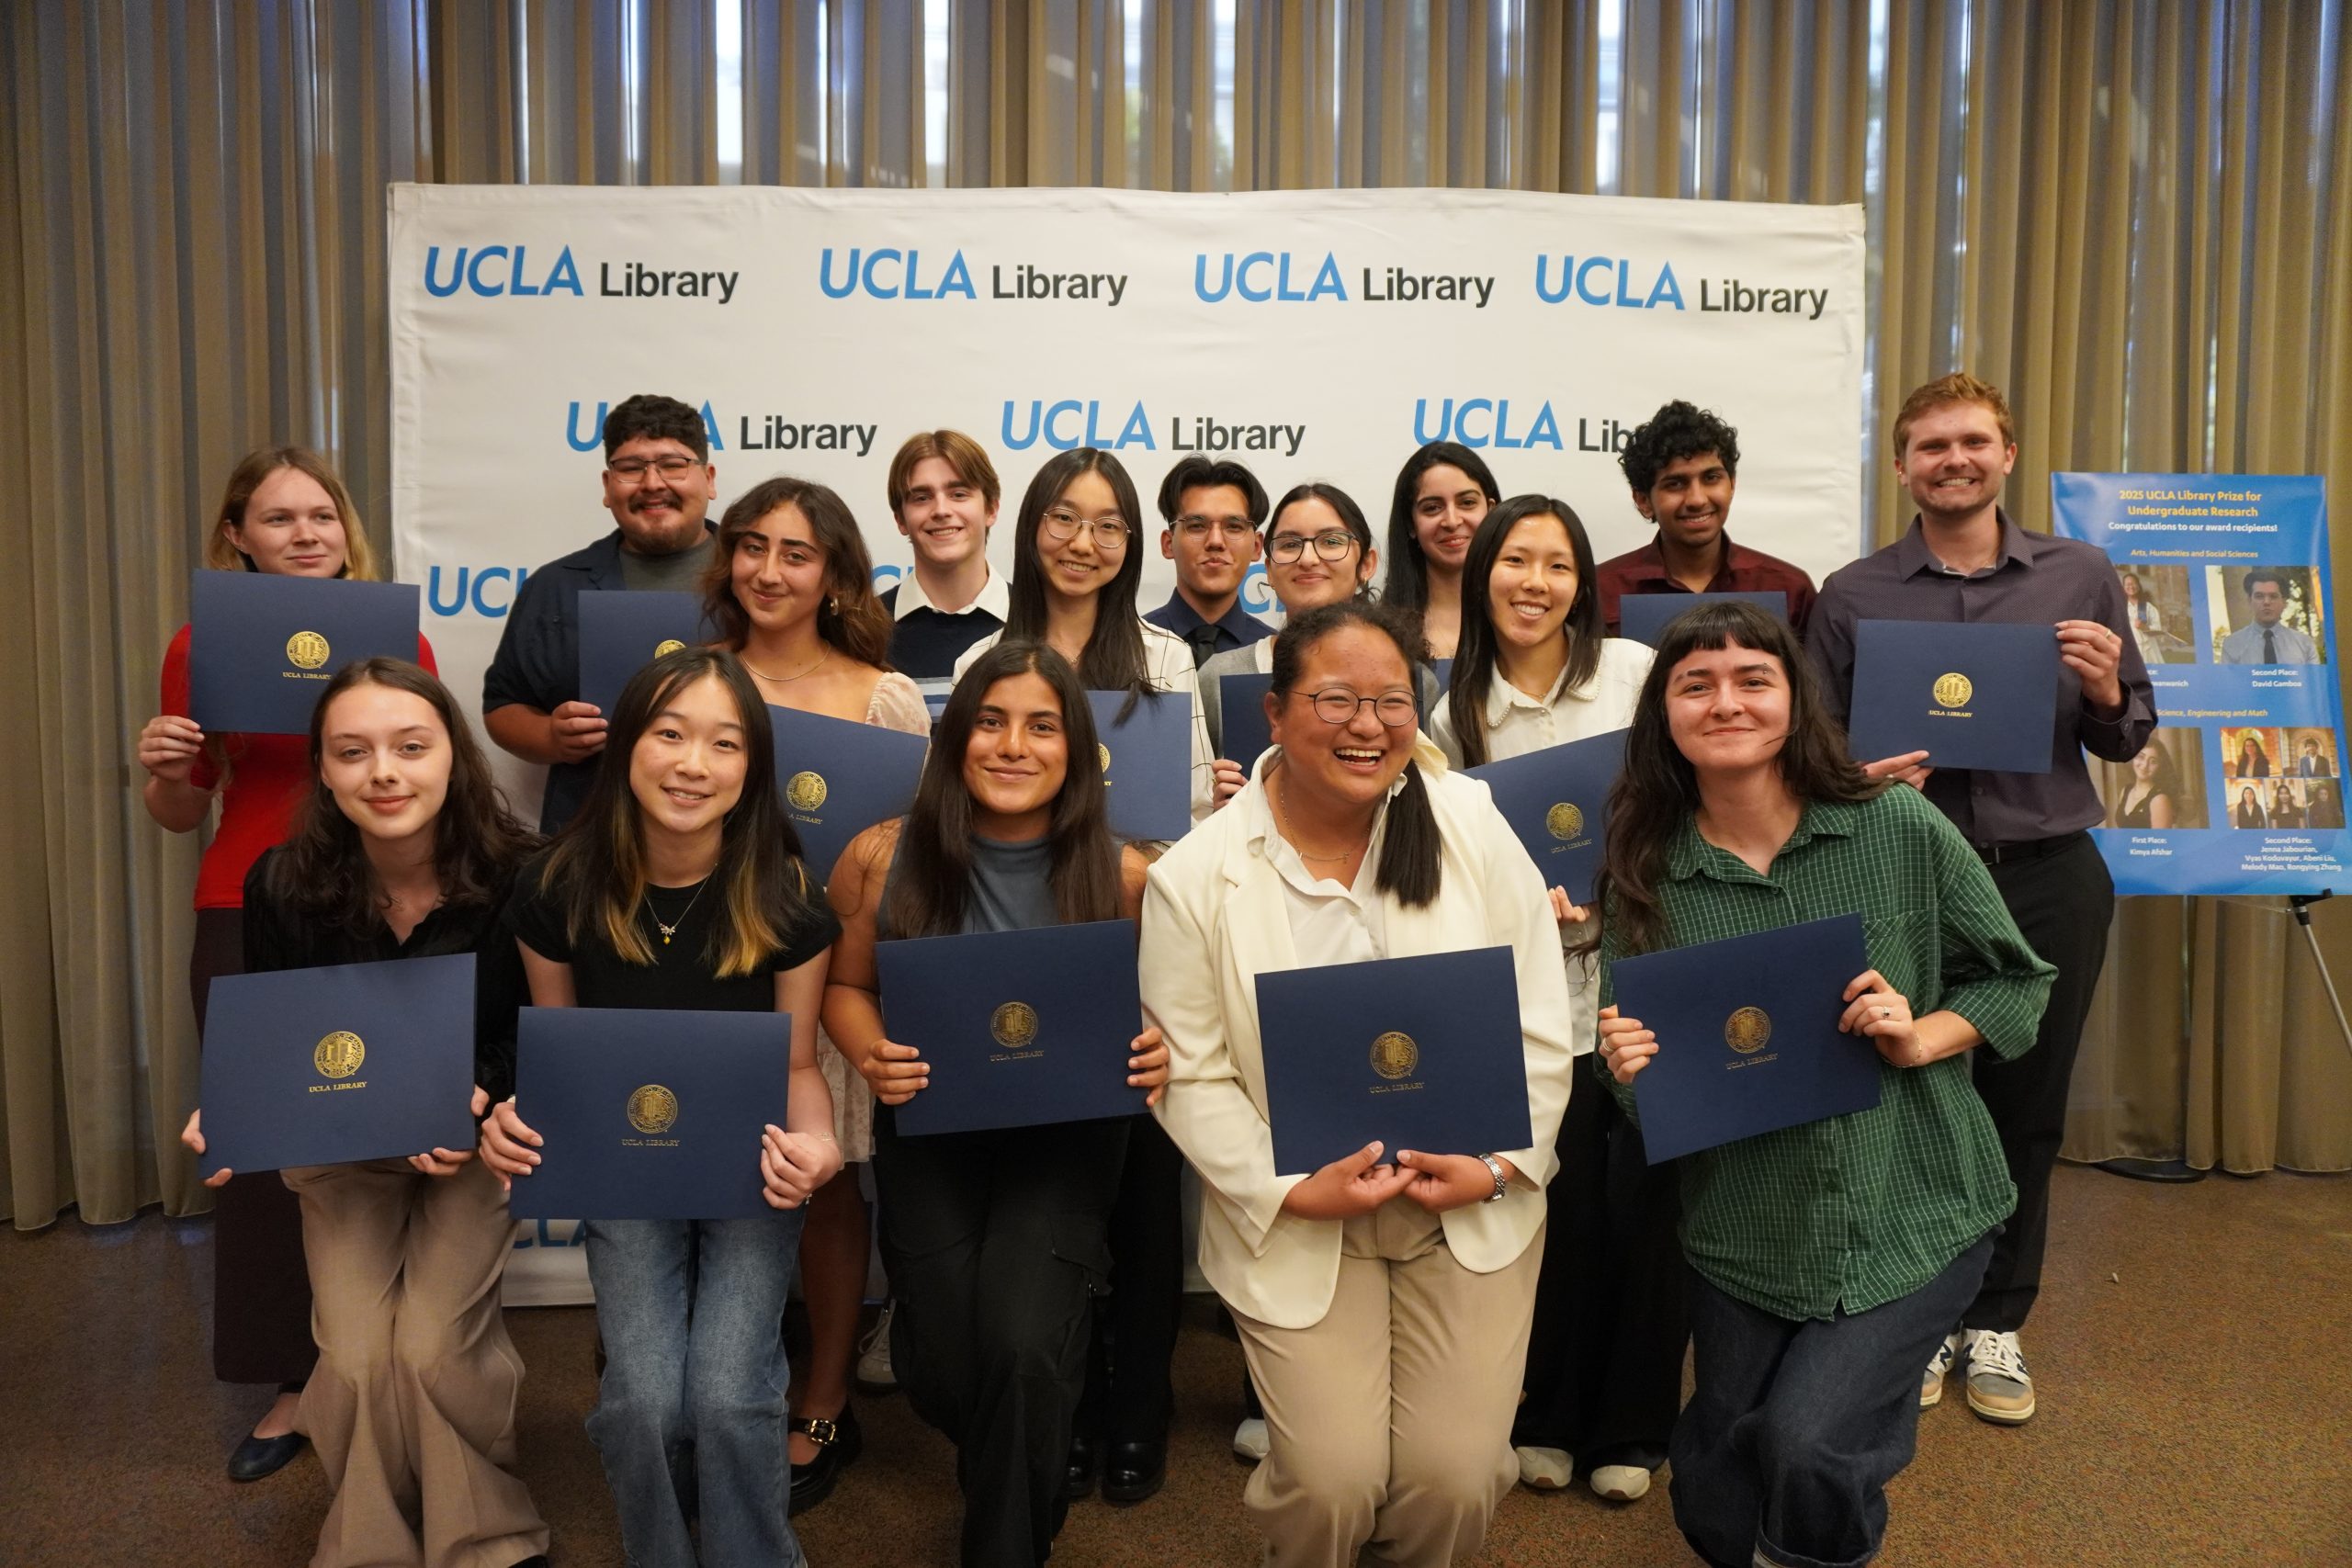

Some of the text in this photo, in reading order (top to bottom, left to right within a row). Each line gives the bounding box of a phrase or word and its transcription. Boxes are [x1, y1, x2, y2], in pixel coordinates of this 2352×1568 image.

[424, 245, 739, 305] UCLA Library
[820, 249, 1128, 307] UCLA Library
[1194, 253, 1495, 309] UCLA Library
[1535, 255, 1828, 321] UCLA Library
[566, 399, 877, 457] UA Library
[1001, 400, 1306, 457] UCLA Library
[1413, 398, 1564, 450] UCLA
[2119, 490, 2262, 502] 2025 UCLA Library Prize for
[2127, 506, 2258, 518] Undergraduate Research
[2109, 522, 2177, 532] Congratulations
[2177, 523, 2188, 531] to
[2205, 523, 2232, 532] award
[2233, 524, 2278, 533] recipients!
[2149, 549, 2189, 558] Humanities
[2190, 549, 2205, 558] and
[2227, 550, 2258, 558] Sciences
[428, 566, 527, 618] UC
[2188, 709, 2232, 718] Engineering
[795, 814, 823, 825] LIBRARY
[309, 1081, 368, 1093] UCLA LIBRARY
